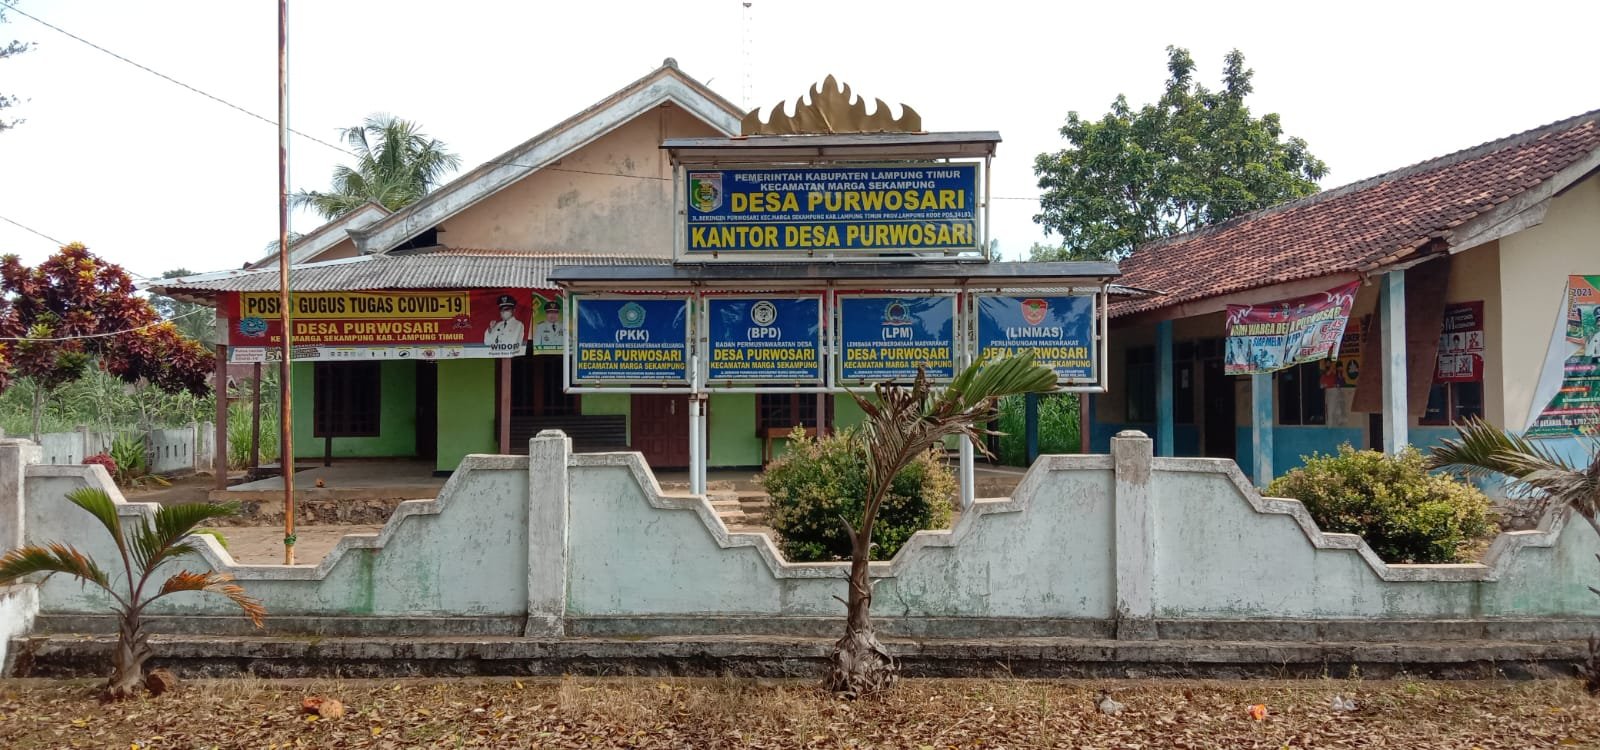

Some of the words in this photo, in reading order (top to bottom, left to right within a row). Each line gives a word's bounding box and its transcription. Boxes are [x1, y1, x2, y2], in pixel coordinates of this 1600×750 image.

[735, 173, 802, 182] PEMERINTAH
[805, 172, 868, 181] KABUPATEN
[871, 171, 923, 180] LAMPUNG
[926, 170, 961, 179] TIMUR
[760, 182, 825, 192] KECAMATAN
[828, 182, 866, 191] MARGA
[868, 181, 935, 190] SEKAMPUNG
[731, 192, 800, 212] DESA
[808, 190, 965, 212] PURWOSARI
[692, 226, 778, 247] KANTOR
[785, 225, 840, 247] DESA
[847, 224, 972, 246] PURWOSARI
[1572, 288, 1592, 297] 2021
[248, 297, 294, 314] POS
[299, 297, 345, 314] GUGUS
[349, 297, 394, 313] TUGAS
[398, 296, 462, 313] COVID-19
[297, 323, 339, 334] DESA
[344, 322, 439, 335] PURWOSARI
[747, 327, 781, 341] (BPD)
[882, 327, 913, 341] (LPM)
[1006, 327, 1063, 340] (LINMAS)
[1249, 323, 1275, 335] WARGA
[615, 329, 649, 342] (PKK)
[581, 349, 611, 361] DESA
[615, 349, 682, 361] PURWOSARI
[714, 349, 744, 361] DESA
[747, 348, 815, 360] PURWOSARI
[847, 348, 877, 360] DESA
[880, 347, 949, 360] PURWOSARI
[1017, 347, 1087, 359] PRWOSARI
[578, 362, 618, 370] KECAMATAN
[620, 362, 642, 370] MARGA
[645, 362, 685, 370] SEKAMPUNG
[777, 361, 818, 369] SEKAMPUNG
[844, 361, 884, 369] KECAMATAN
[886, 361, 909, 369] MARGA
[911, 360, 952, 368] SEMPUNG
